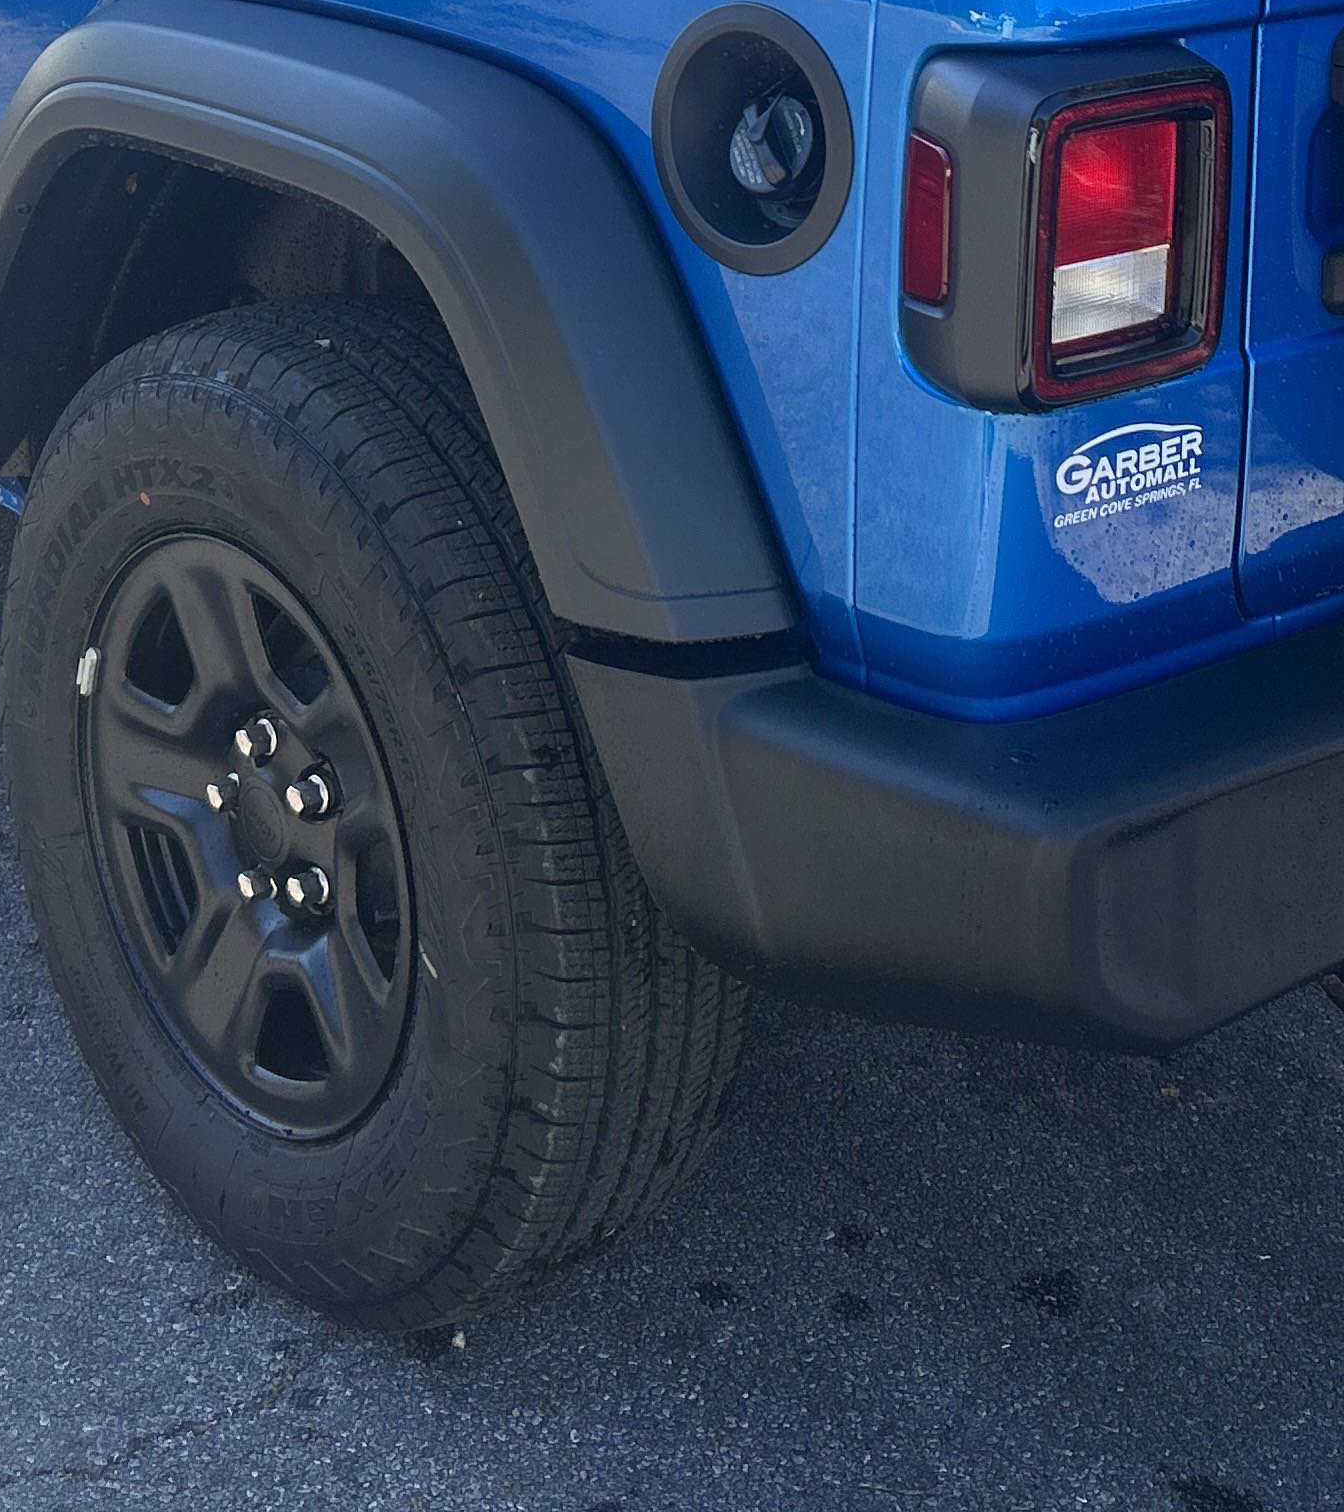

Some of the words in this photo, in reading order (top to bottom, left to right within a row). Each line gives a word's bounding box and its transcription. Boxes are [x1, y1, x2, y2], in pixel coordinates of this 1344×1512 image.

[1056, 431, 1203, 495] GARBER
[1085, 457, 1201, 505] AUTOMALL
[1054, 506, 1098, 528] GREEN
[1099, 498, 1133, 517] COVE
[1135, 483, 1186, 507] SPRINGS,
[1188, 477, 1202, 491] FL
